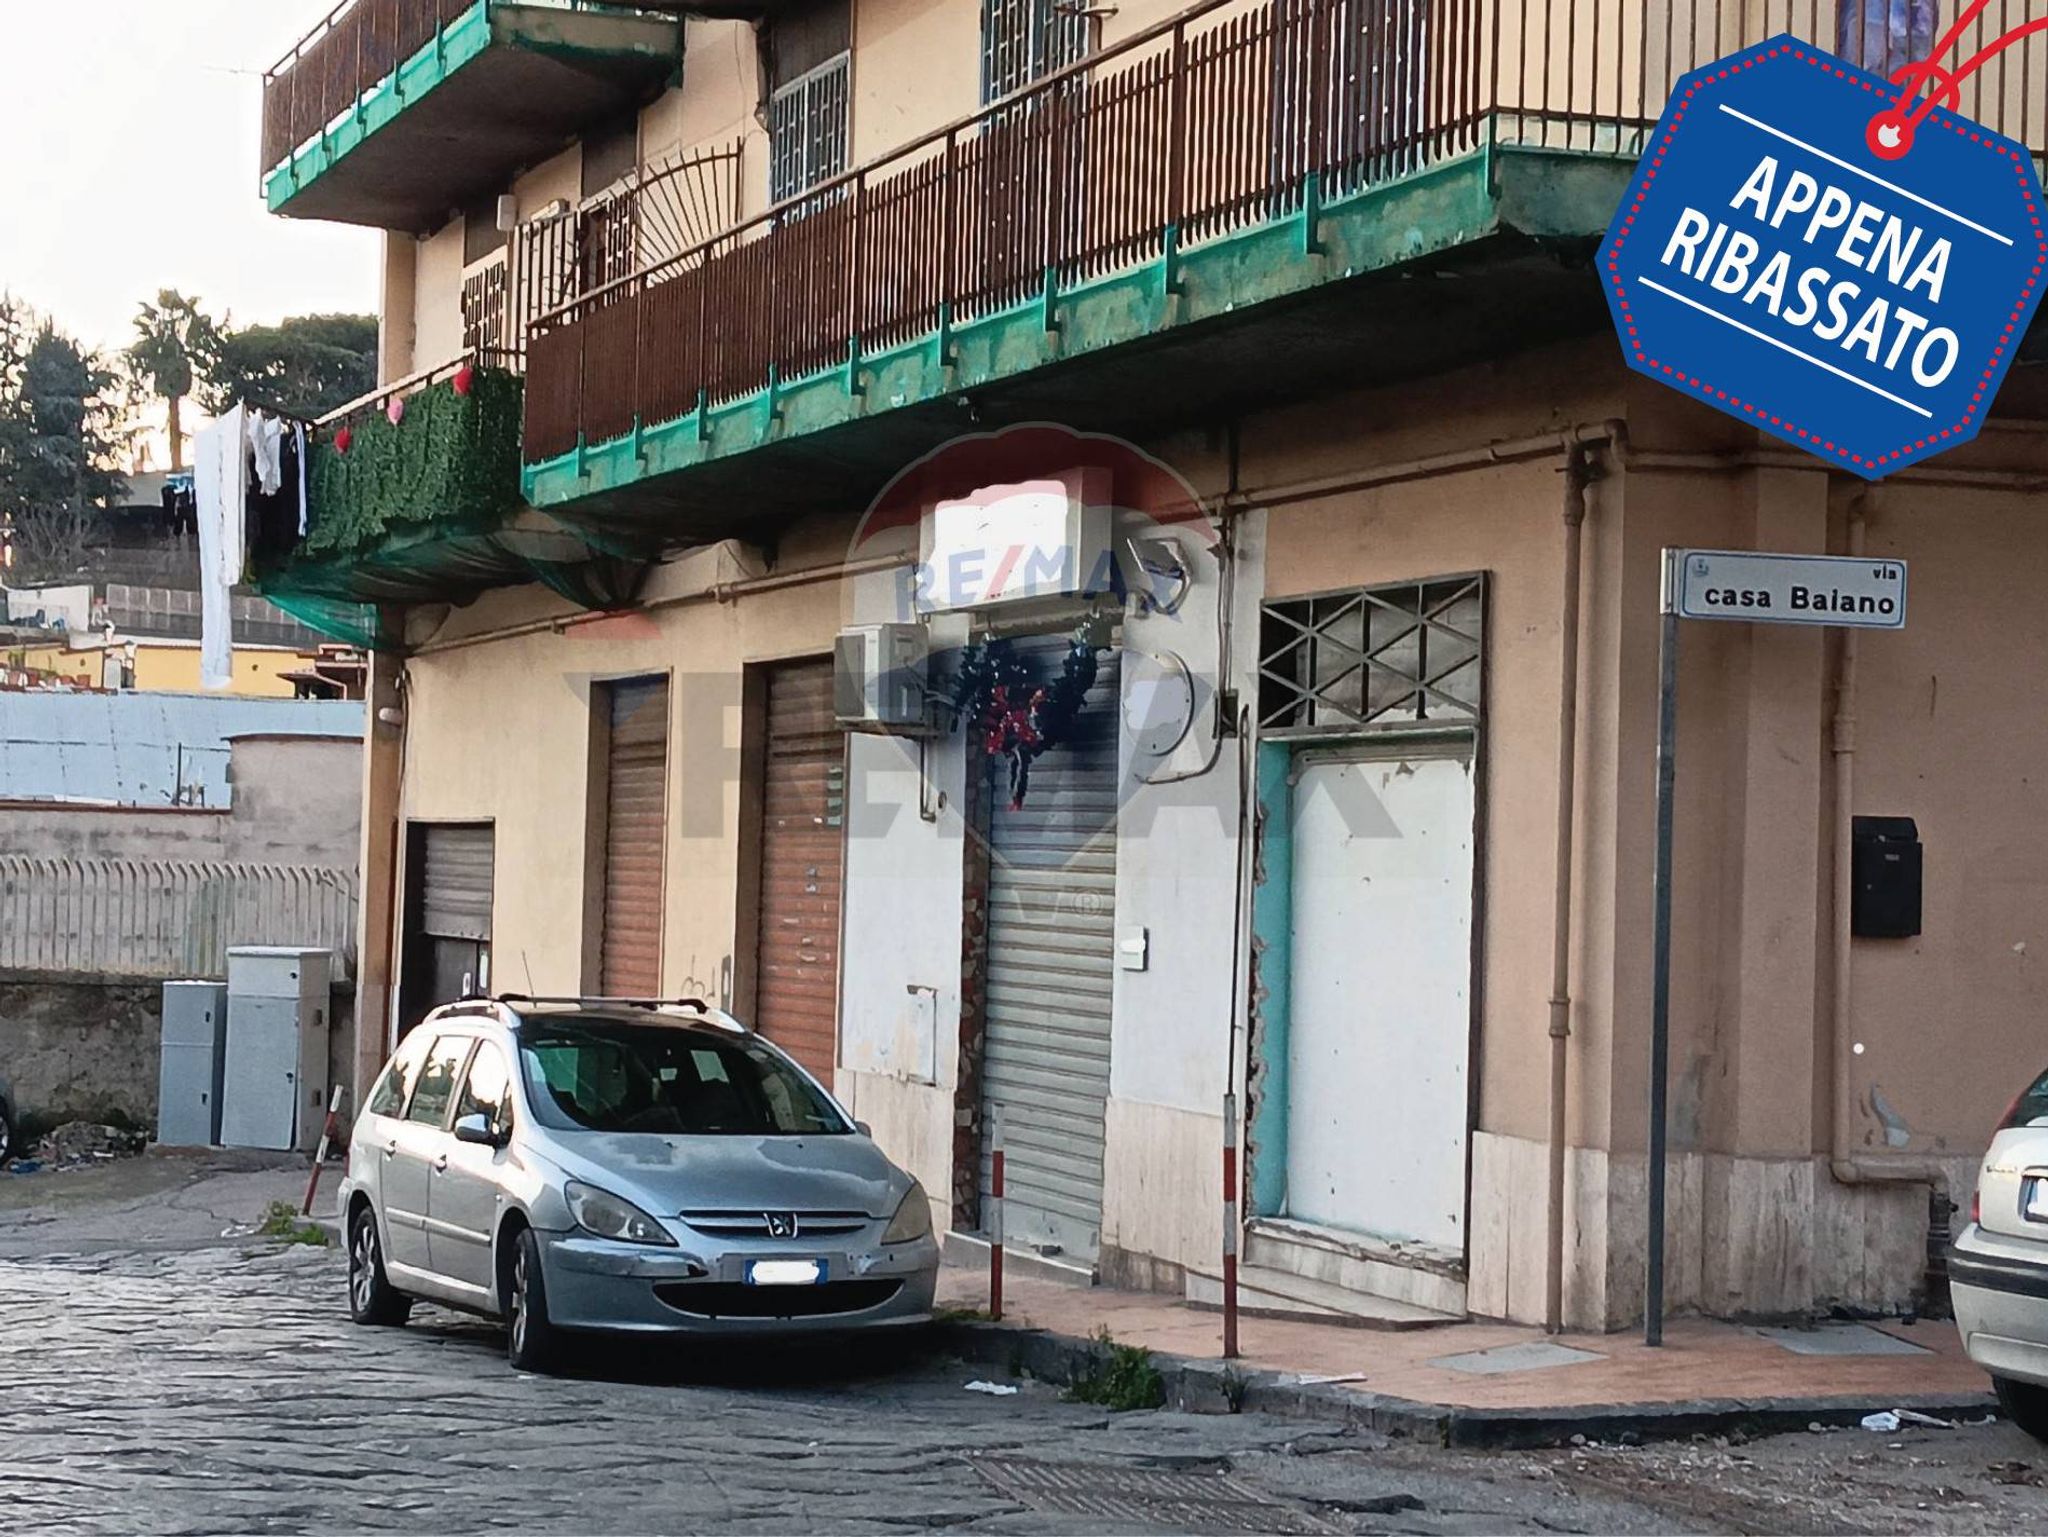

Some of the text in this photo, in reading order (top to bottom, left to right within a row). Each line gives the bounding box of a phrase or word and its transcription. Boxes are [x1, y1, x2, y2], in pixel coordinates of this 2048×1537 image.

[1872, 563, 1898, 580] via
[1704, 586, 1895, 615] casa Baiano
